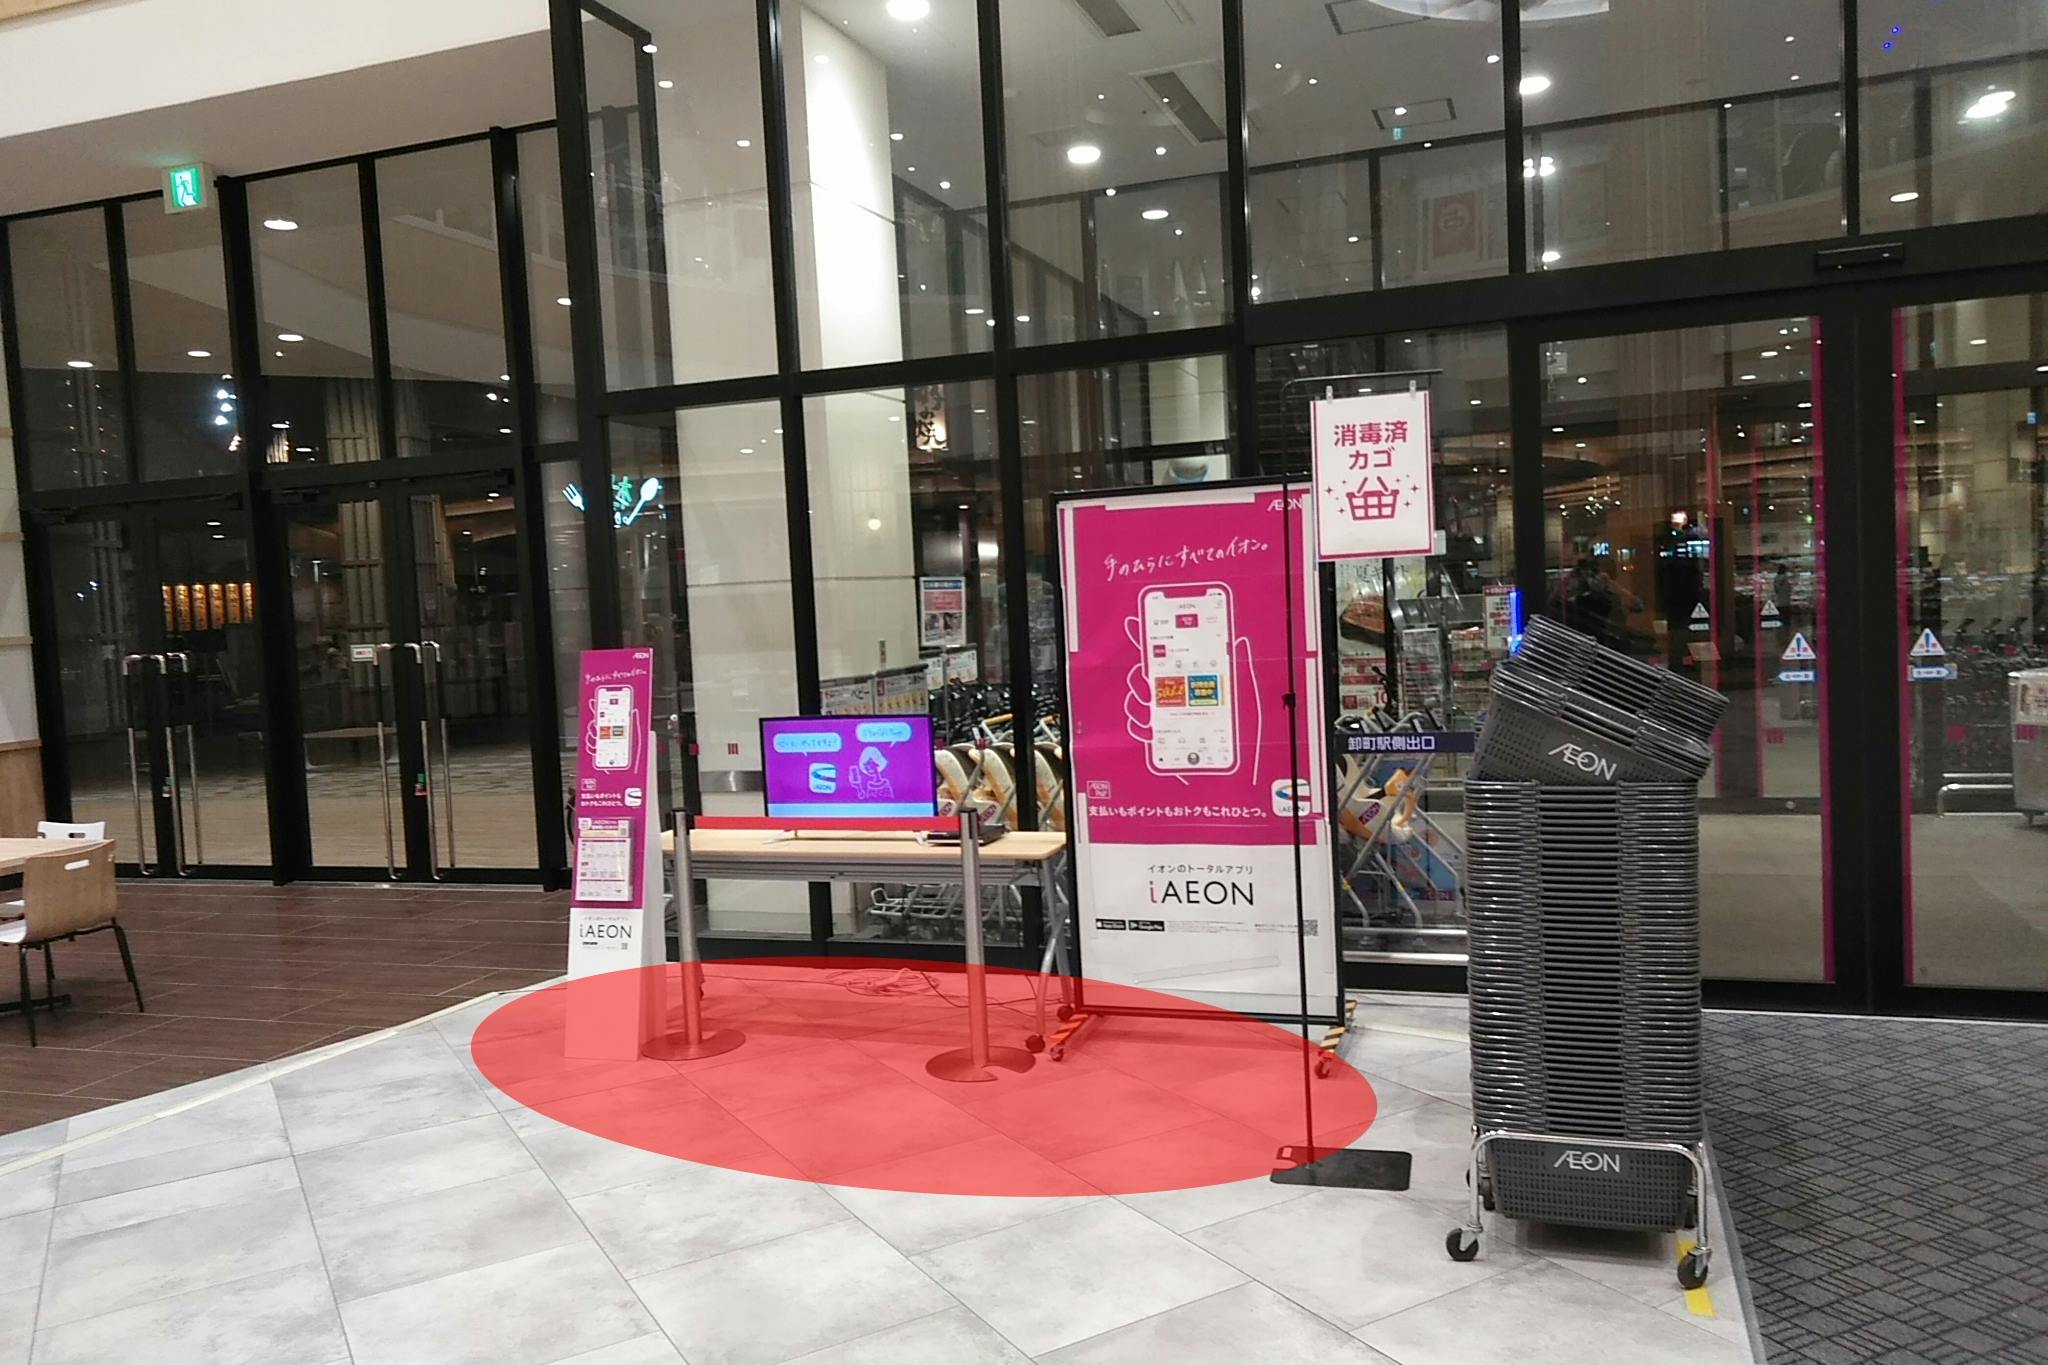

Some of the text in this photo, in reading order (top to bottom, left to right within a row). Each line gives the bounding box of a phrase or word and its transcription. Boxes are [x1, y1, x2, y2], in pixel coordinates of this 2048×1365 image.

[1334, 420, 1408, 447] 消毒済
[1348, 446, 1395, 470] カゴ
[1348, 736, 1435, 751] 卸町駅側出口
[1088, 805, 1267, 818] 支払いもポイントもおトクもこれひとつ。
[1147, 863, 1254, 875] イオンのトータルアプリ
[1149, 880, 1254, 906] iAEON
[579, 923, 632, 939] iAEON
